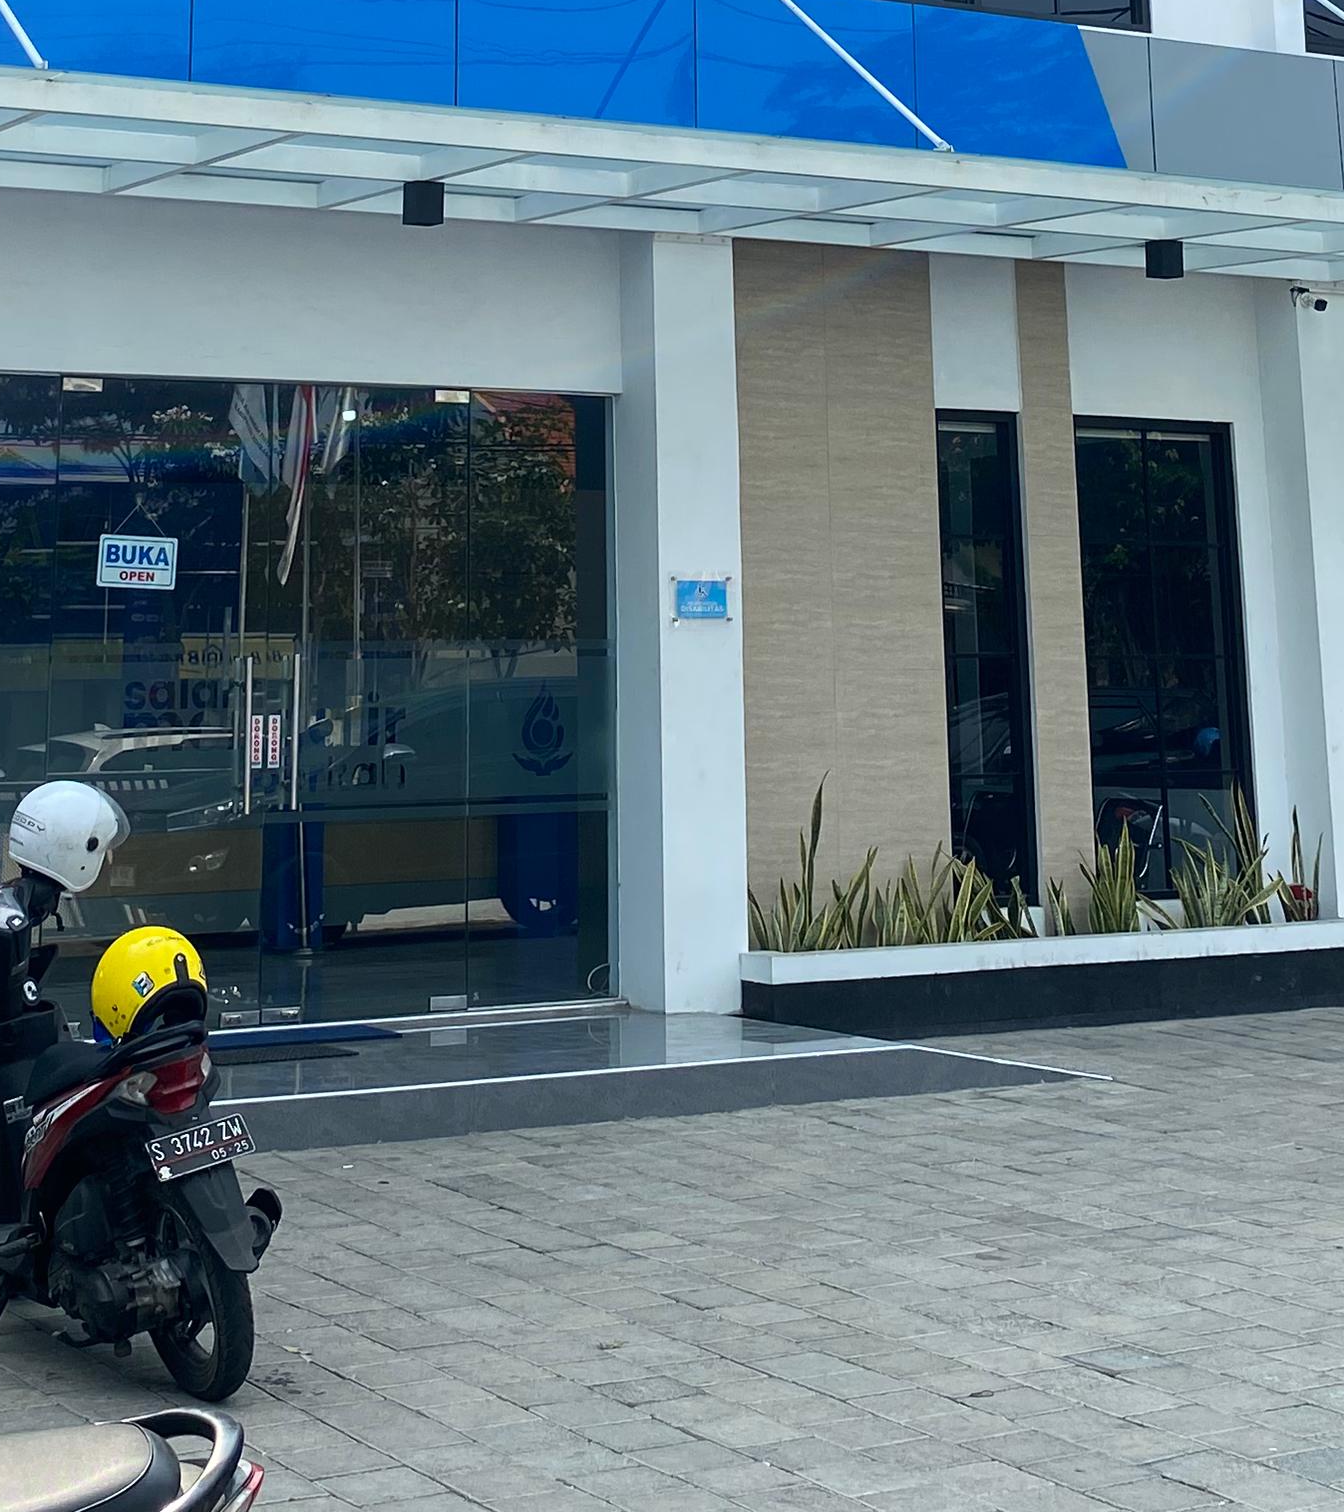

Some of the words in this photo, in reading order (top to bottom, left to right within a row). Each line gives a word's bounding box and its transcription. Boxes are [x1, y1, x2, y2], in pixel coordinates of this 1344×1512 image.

[105, 544, 169, 566] BUKA
[119, 571, 155, 582] OPEN
[253, 718, 261, 761] DORONG
[151, 1143, 165, 1161] S
[170, 1127, 214, 1155] 3742
[217, 1117, 243, 1141] ZW
